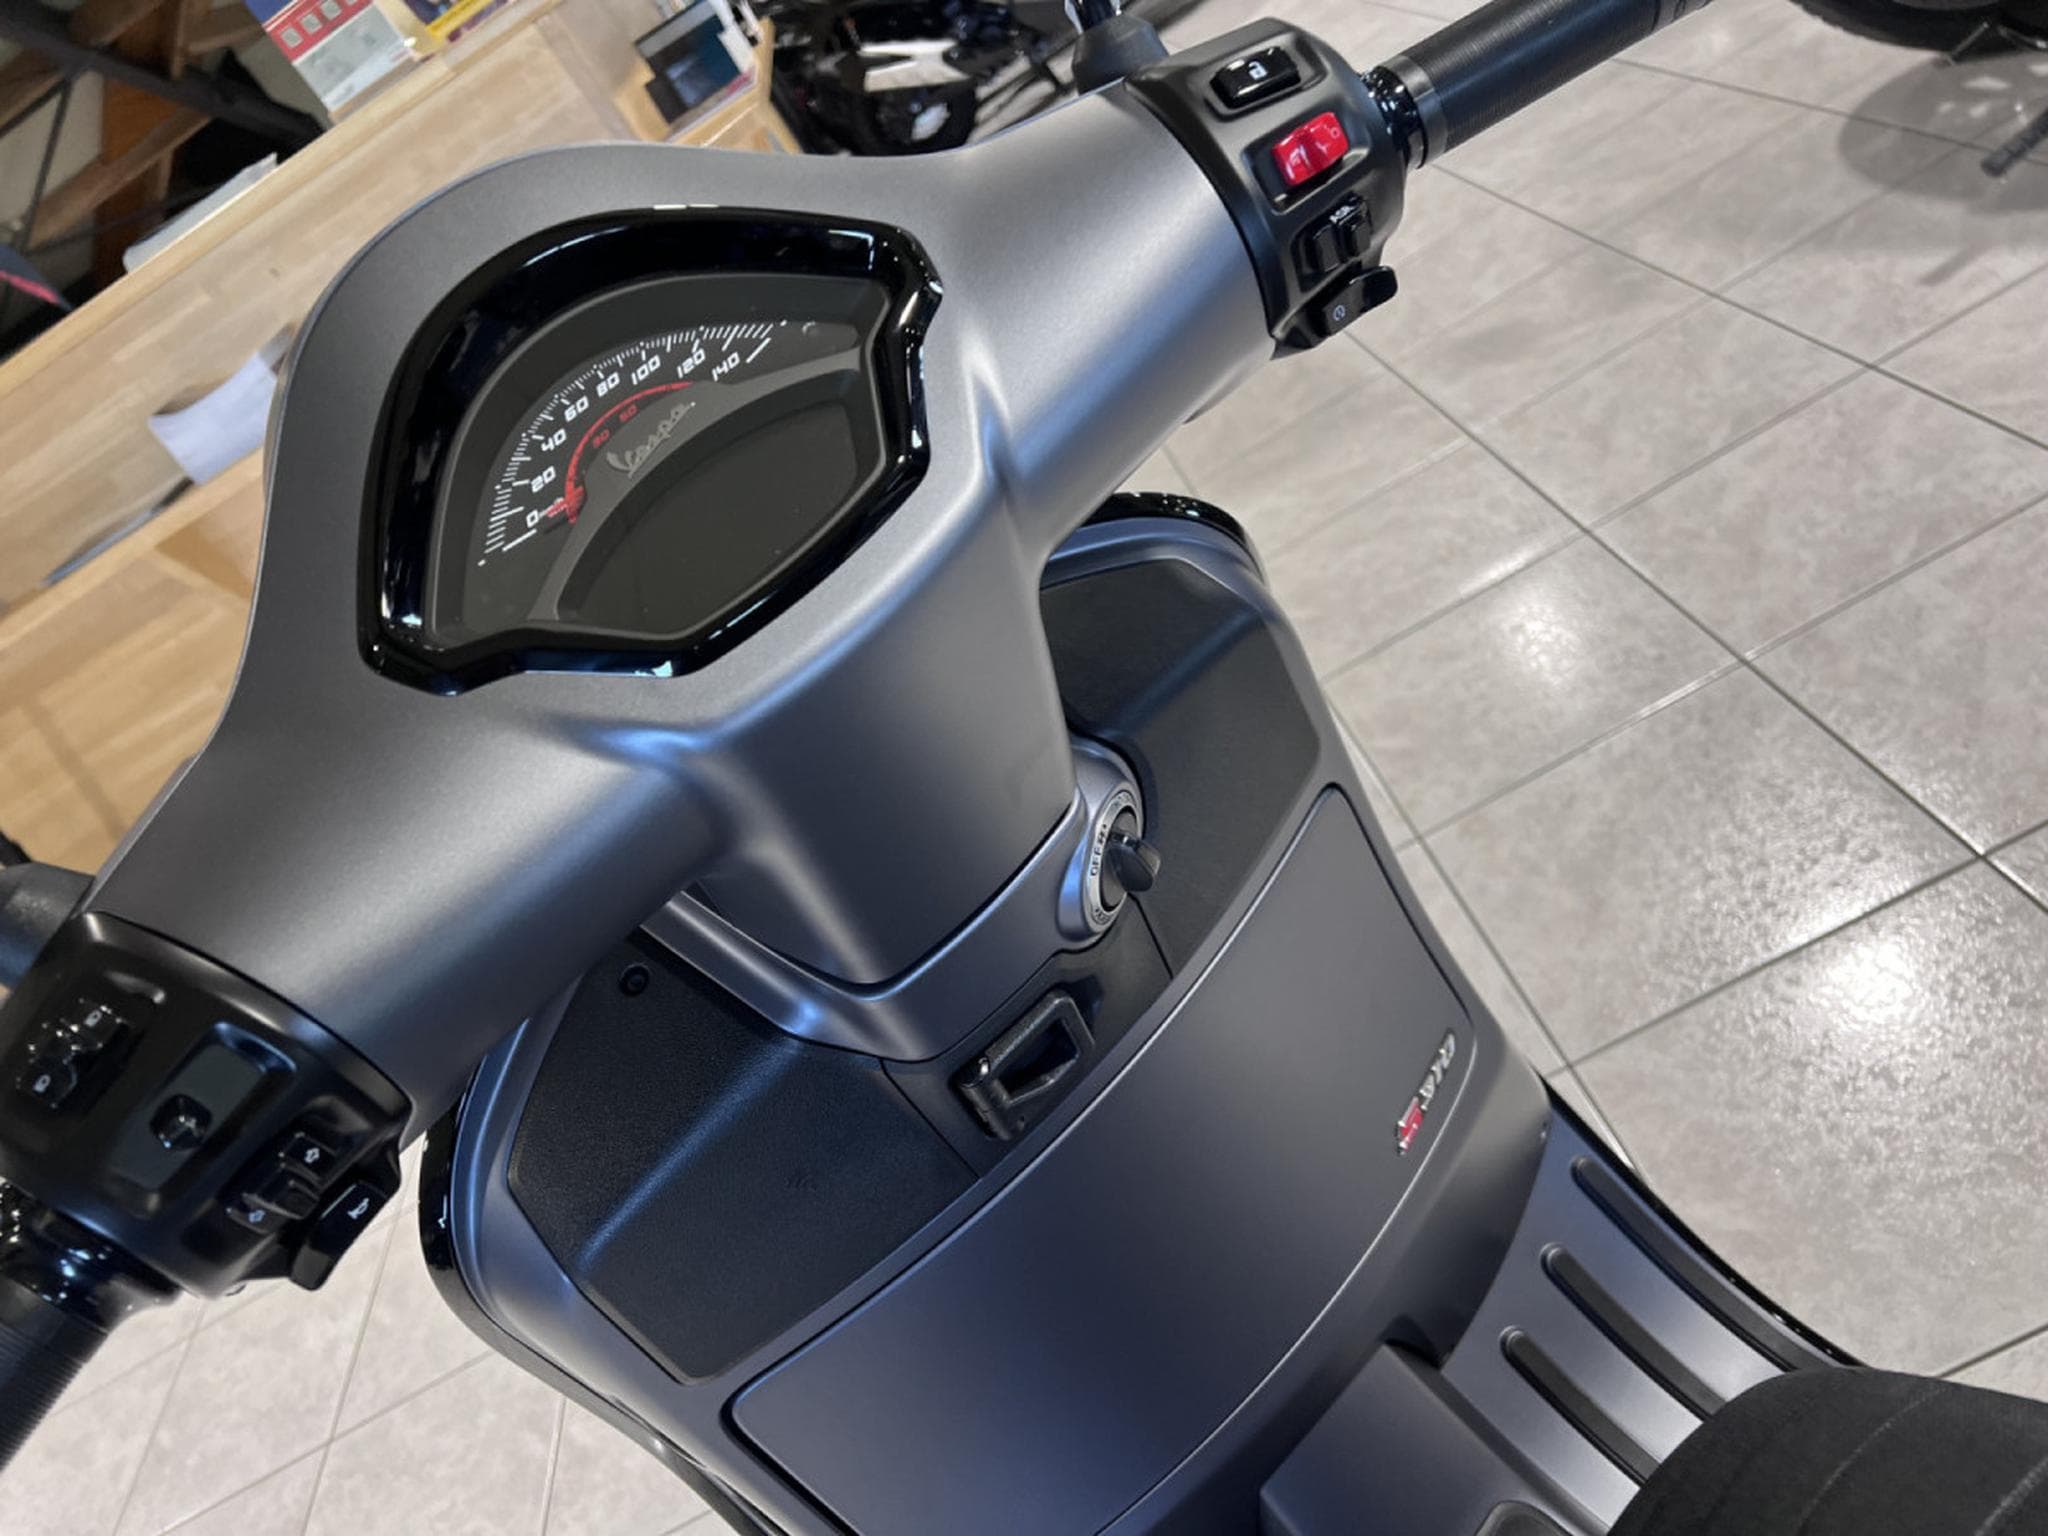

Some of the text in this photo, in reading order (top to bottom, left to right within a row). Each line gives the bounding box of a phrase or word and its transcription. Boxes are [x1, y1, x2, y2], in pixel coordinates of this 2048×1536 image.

[631, 354, 661, 386] 100
[676, 347, 706, 378] 120
[711, 351, 740, 381] 140
[596, 371, 620, 397] 80
[564, 395, 589, 422] 60
[541, 430, 567, 452] 40
[606, 402, 697, 478] Vespa
[530, 465, 556, 493] 20
[526, 509, 540, 528] 0
